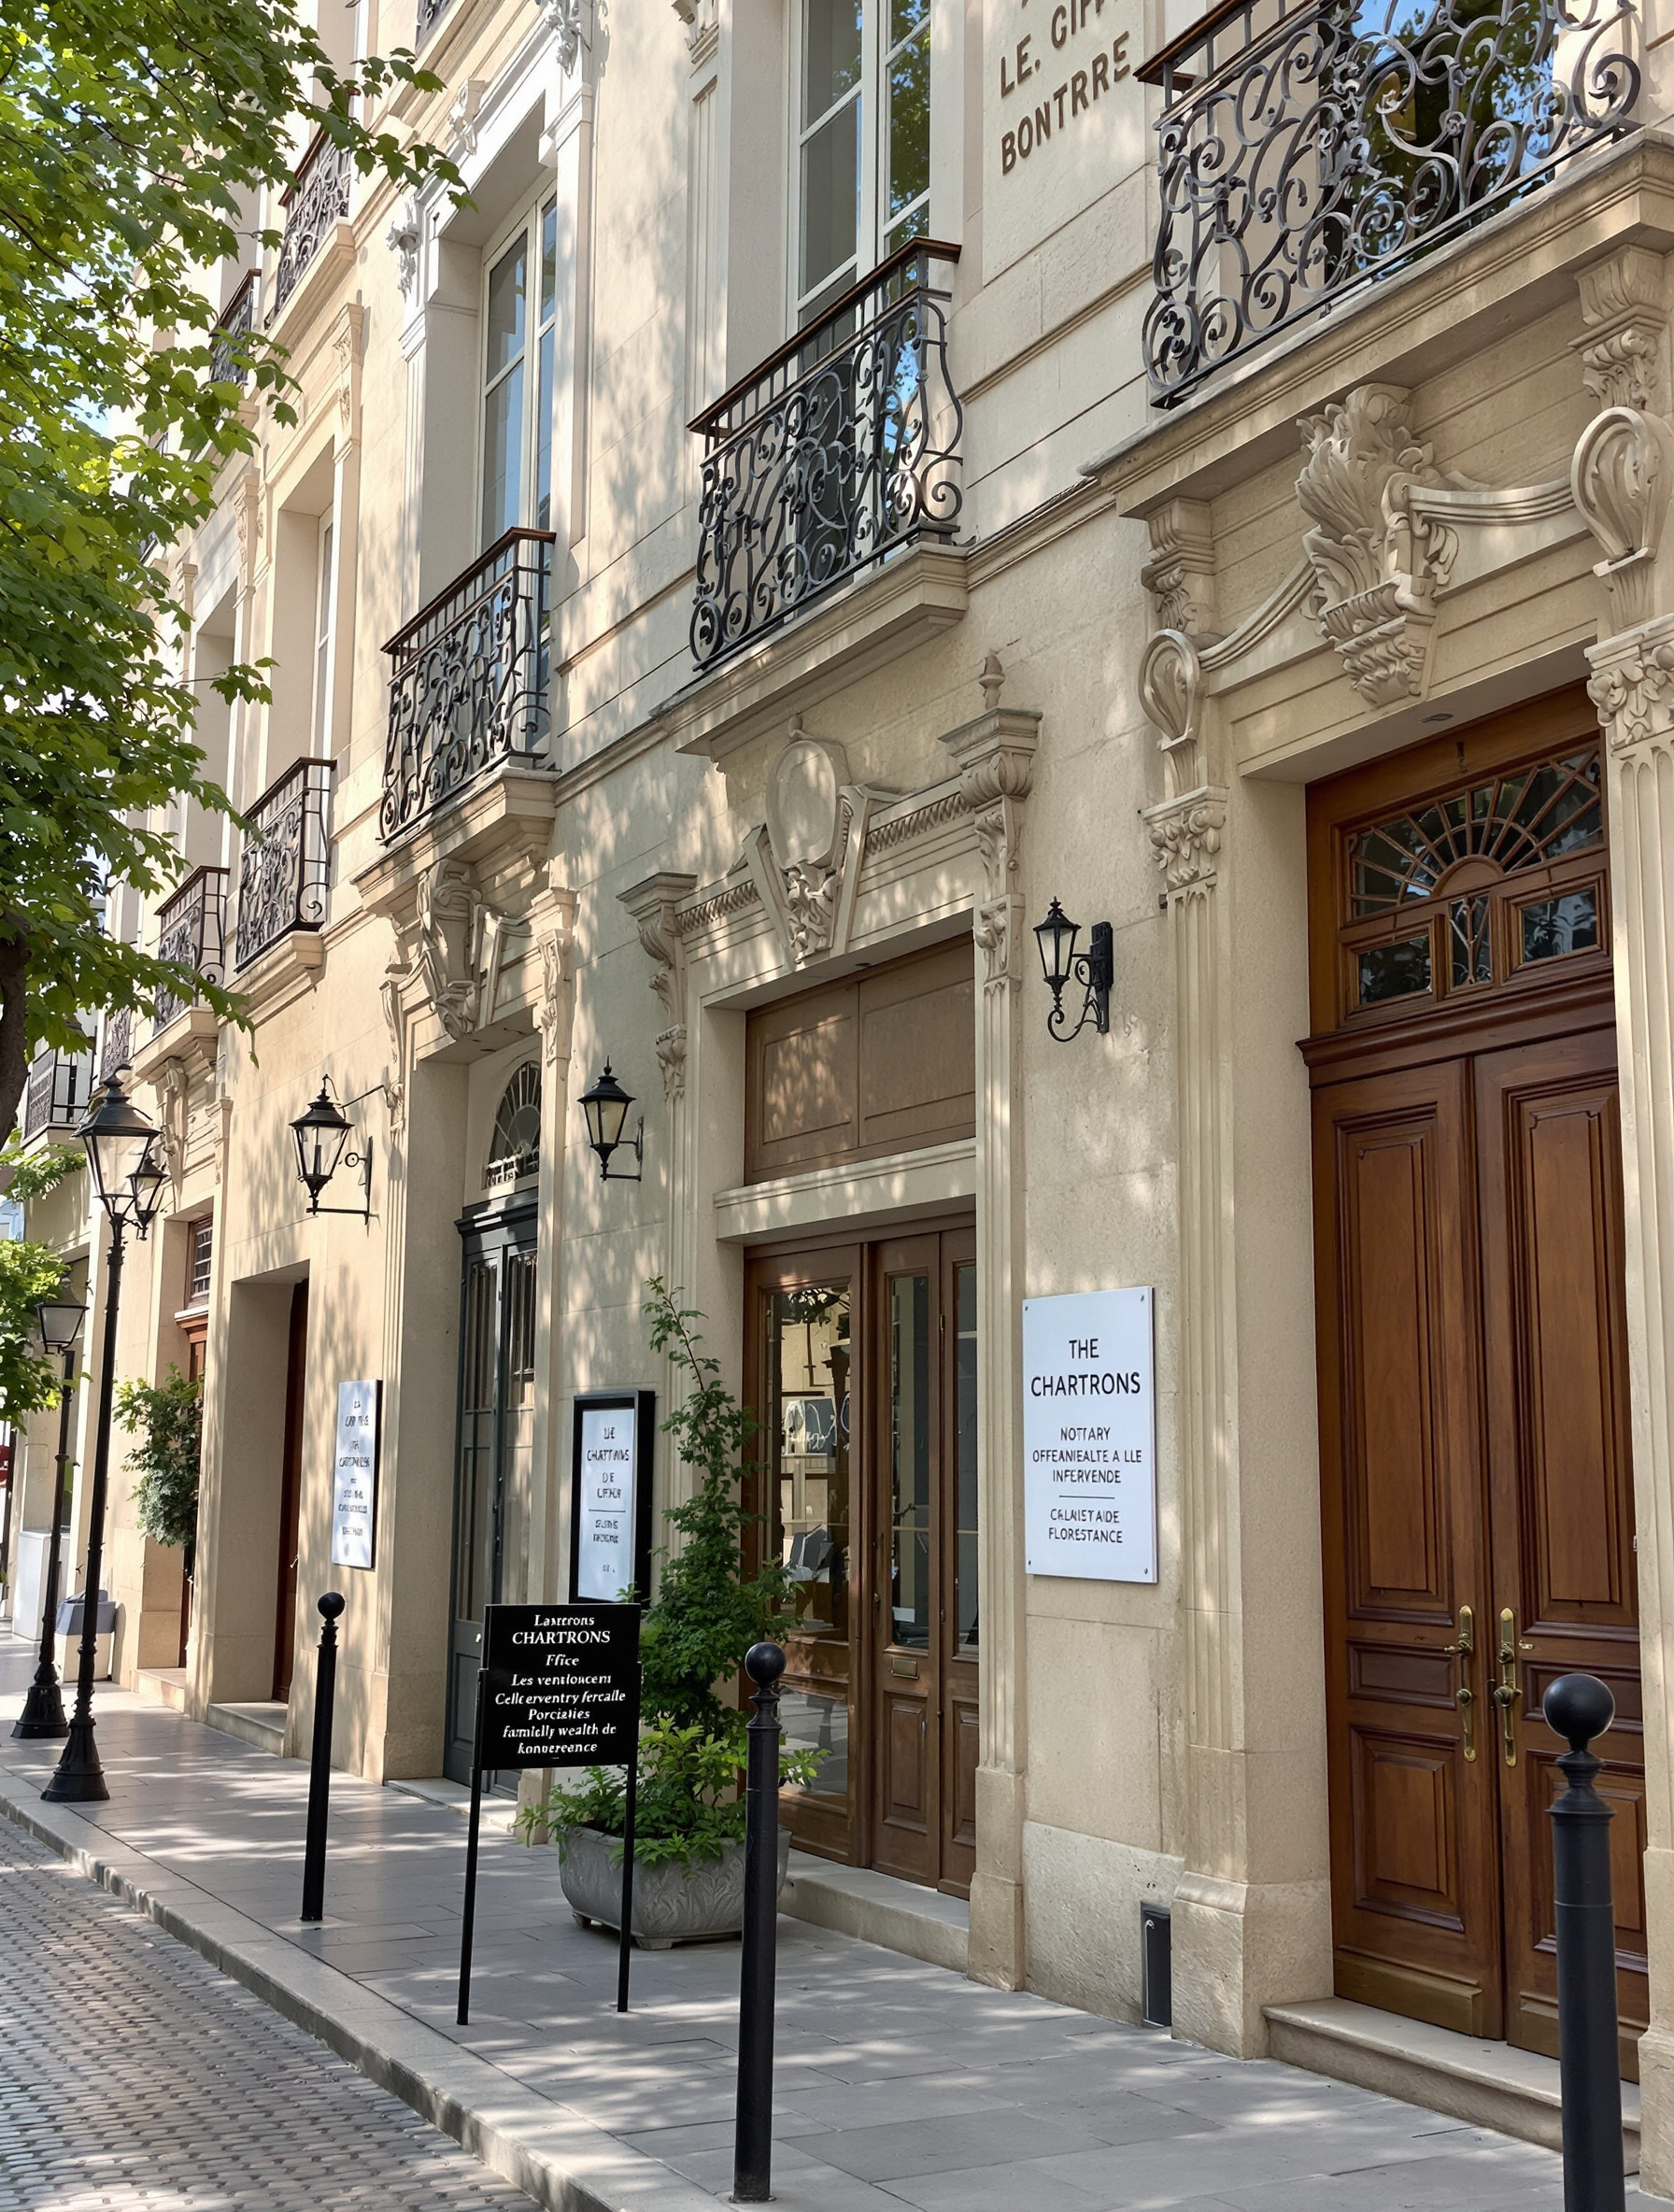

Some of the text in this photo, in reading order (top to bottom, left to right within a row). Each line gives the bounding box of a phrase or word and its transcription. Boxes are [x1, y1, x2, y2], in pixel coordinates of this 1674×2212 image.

[1068, 1338, 1099, 1359] THE
[1030, 1371, 1141, 1397] CHARTRONS
[1048, 1527, 1123, 1543] FLORESTANCE
[512, 1630, 611, 1644] CHARTRONS
[510, 1673, 533, 1686] Les
[558, 1723, 599, 1736] wealth
